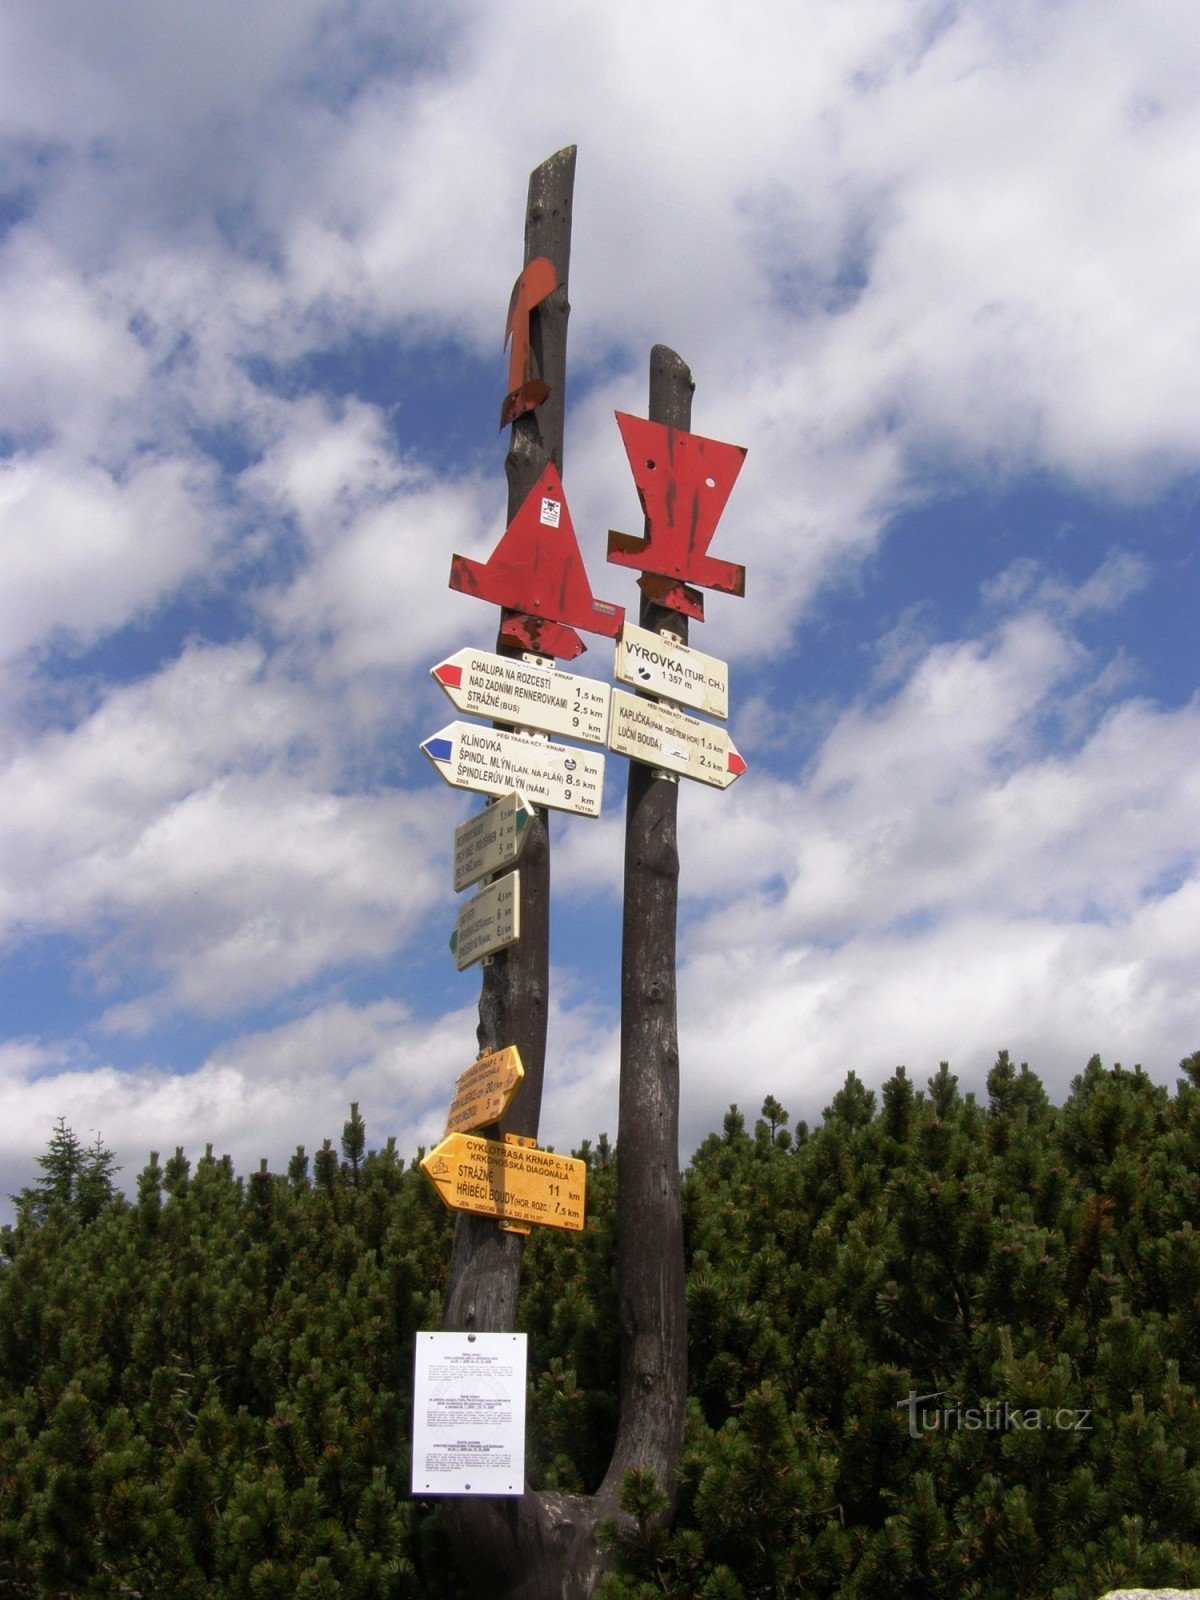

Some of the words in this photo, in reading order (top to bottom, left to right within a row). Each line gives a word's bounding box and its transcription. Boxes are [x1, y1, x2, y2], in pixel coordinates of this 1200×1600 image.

[472, 661, 504, 678] CHALUPA
[506, 669, 515, 680] NA
[592, 694, 603, 703] km
[626, 641, 683, 674] VÝROVKA
[684, 668, 706, 683] (TUR.
[708, 678, 725, 693] CH.)
[669, 673, 682, 685] 357
[468, 691, 500, 708] STRÁŽNÉ
[500, 702, 520, 714] (BUS)
[572, 717, 579, 727] 9
[588, 724, 600, 732] km
[469, 676, 484, 688] NAD
[485, 680, 513, 696] ZADNÍMI
[515, 687, 568, 709] RENNEROVKAMI
[590, 709, 602, 718] km
[618, 725, 636, 740] LUČNÍ
[638, 733, 658, 748] BOUDA
[713, 762, 722, 772] km
[620, 707, 649, 726] KAPLIČKA
[714, 744, 723, 754] km
[459, 747, 487, 765] ŠPINDL.
[490, 756, 511, 770] MLÝN
[511, 764, 530, 775] (LAN.
[532, 769, 541, 777] NA
[583, 781, 596, 790] km
[461, 734, 502, 752] KLÍNOVKA
[584, 766, 597, 775] km
[505, 775, 525, 789] MLÝN
[526, 784, 549, 796] (NÁM.)
[564, 789, 572, 800] 9
[581, 796, 594, 805] km
[499, 844, 503, 855] 5
[486, 1098, 490, 1109] 5
[466, 1141, 524, 1161] CYKLOTRASA
[526, 1154, 554, 1166] KRNAP
[565, 1162, 574, 1172] 1A
[471, 1153, 524, 1172] KRKONOŠSKÁ
[526, 1164, 569, 1181] DIAGONÁLA
[457, 1180, 487, 1200] HŘÍBĚCÍ
[489, 1188, 515, 1205] BOUDY
[567, 1208, 579, 1218] km
[458, 1164, 493, 1183] STRÁŽNÉ
[548, 1184, 559, 1196] 11
[568, 1192, 580, 1201] km
